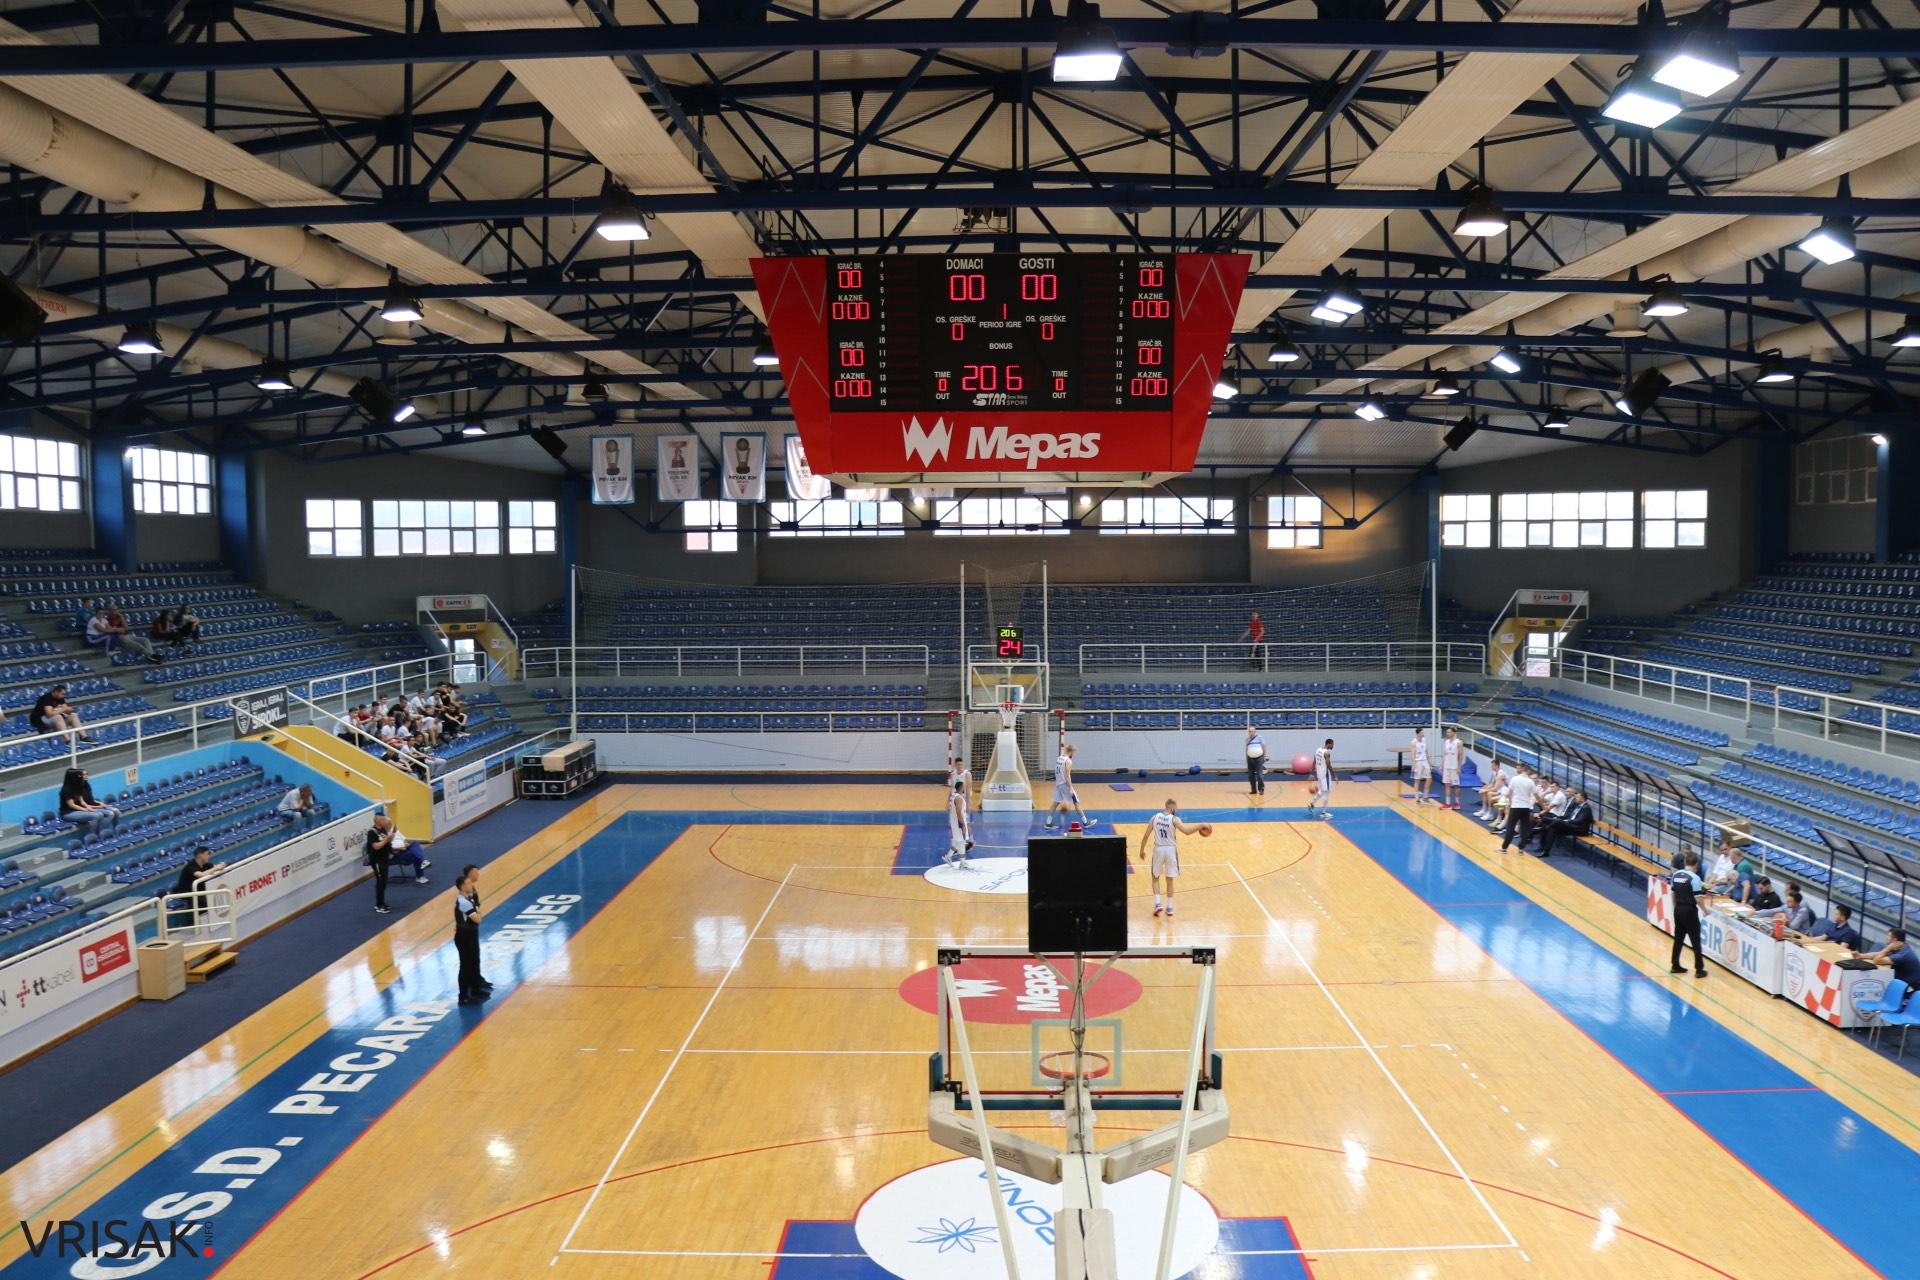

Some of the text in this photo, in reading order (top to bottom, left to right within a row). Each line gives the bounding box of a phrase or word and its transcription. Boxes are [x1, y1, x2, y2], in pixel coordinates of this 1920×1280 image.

[946, 258, 1055, 270] DOMACI GOSTI
[839, 270, 861, 288] 00
[1022, 274, 1057, 300] 00
[1141, 269, 1163, 287] 00
[950, 275, 985, 300] 00
[949, 315, 976, 323] GREŠKE
[952, 323, 964, 340] 0
[1042, 322, 1054, 340] 0
[841, 349, 864, 366] 00
[1139, 347, 1161, 365] 00
[939, 379, 947, 391] 0
[1056, 378, 1064, 391] 0
[966, 426, 1101, 470] Mepas
[1000, 640, 1021, 655] 24
[235, 871, 277, 900] HT ERONET
[1016, 965, 1069, 1012] Mepas
[268, 998, 457, 1115] PECARA
